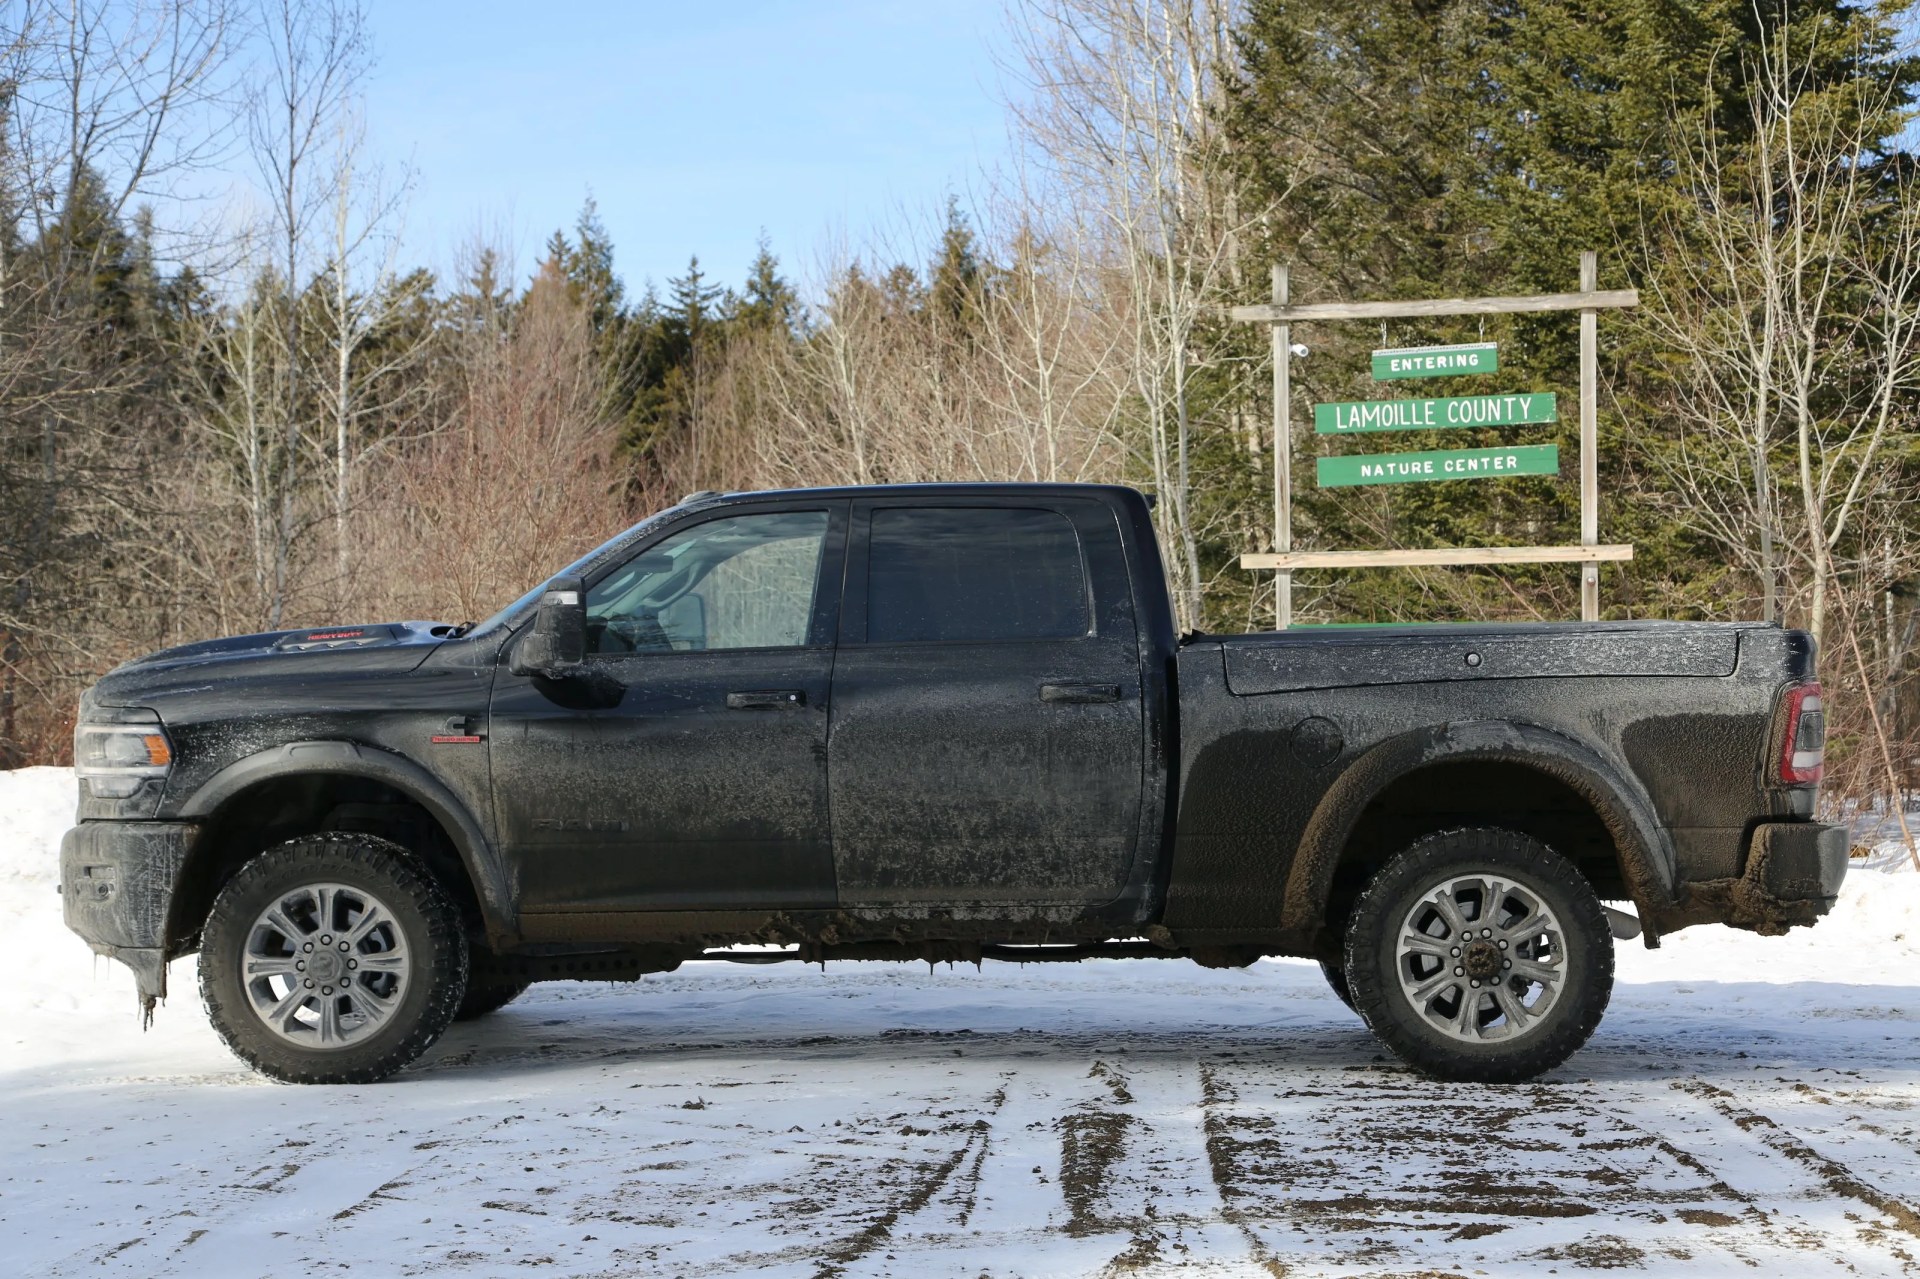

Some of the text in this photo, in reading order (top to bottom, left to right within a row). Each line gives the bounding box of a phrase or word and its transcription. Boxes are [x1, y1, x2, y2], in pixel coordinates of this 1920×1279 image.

[1389, 353, 1480, 373] ENTERING
[1336, 396, 1532, 429] LAMOILLE COUNTY
[1360, 455, 1518, 477] NATURE CENTER
